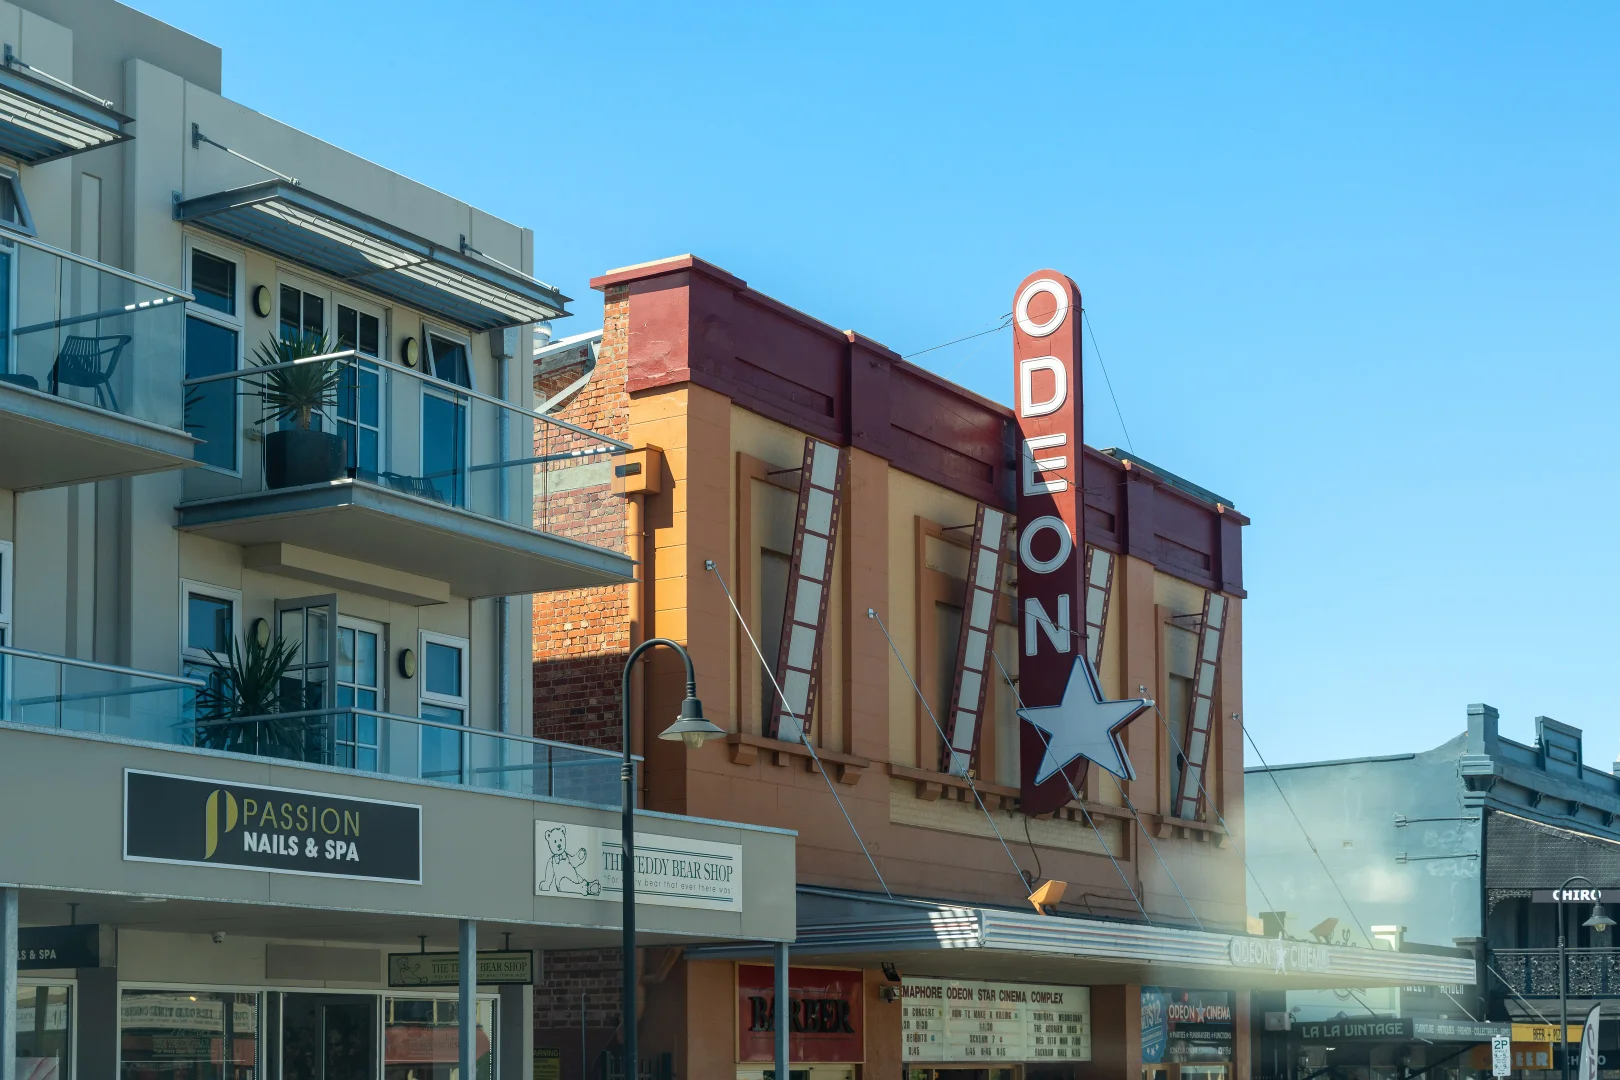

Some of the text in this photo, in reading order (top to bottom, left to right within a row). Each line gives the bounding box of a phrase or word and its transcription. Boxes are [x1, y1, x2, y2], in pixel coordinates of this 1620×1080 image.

[1015, 277, 1072, 656] ODEON
[243, 798, 360, 837] PASSION
[243, 831, 360, 862] NAILS & SPA
[672, 859, 703, 880] BEAR
[704, 862, 733, 882] SHOP
[645, 878, 662, 888] bear
[663, 881, 678, 890] that
[680, 883, 697, 892] ever
[1552, 888, 1602, 901] CHIRO
[29, 949, 37, 960] &
[39, 949, 57, 960] SPA
[1232, 940, 1328, 969] ODEON CINEMA
[431, 963, 449, 974] THE
[480, 962, 503, 973] BEAR
[504, 961, 528, 972] SHOP
[946, 986, 974, 1001] ODEON
[977, 988, 997, 1001] STAR
[998, 989, 1028, 1003] CINEMA
[1030, 991, 1064, 1005] COMPLEX
[912, 1008, 934, 1017] CONCERT
[974, 1010, 986, 1019] MAKE
[1168, 1004, 1195, 1019] ODEON
[1206, 1005, 1232, 1020] CINEMA
[1302, 1022, 1404, 1038] LA LA VINTAGE
[1533, 1028, 1546, 1041] BEER
[906, 1033, 928, 1043] HEIGHTS
[969, 1034, 988, 1044] SCREAM
[1494, 1040, 1508, 1050] 2P
[533, 1049, 559, 1057] ARNING
[1510, 1052, 1549, 1067] EER
